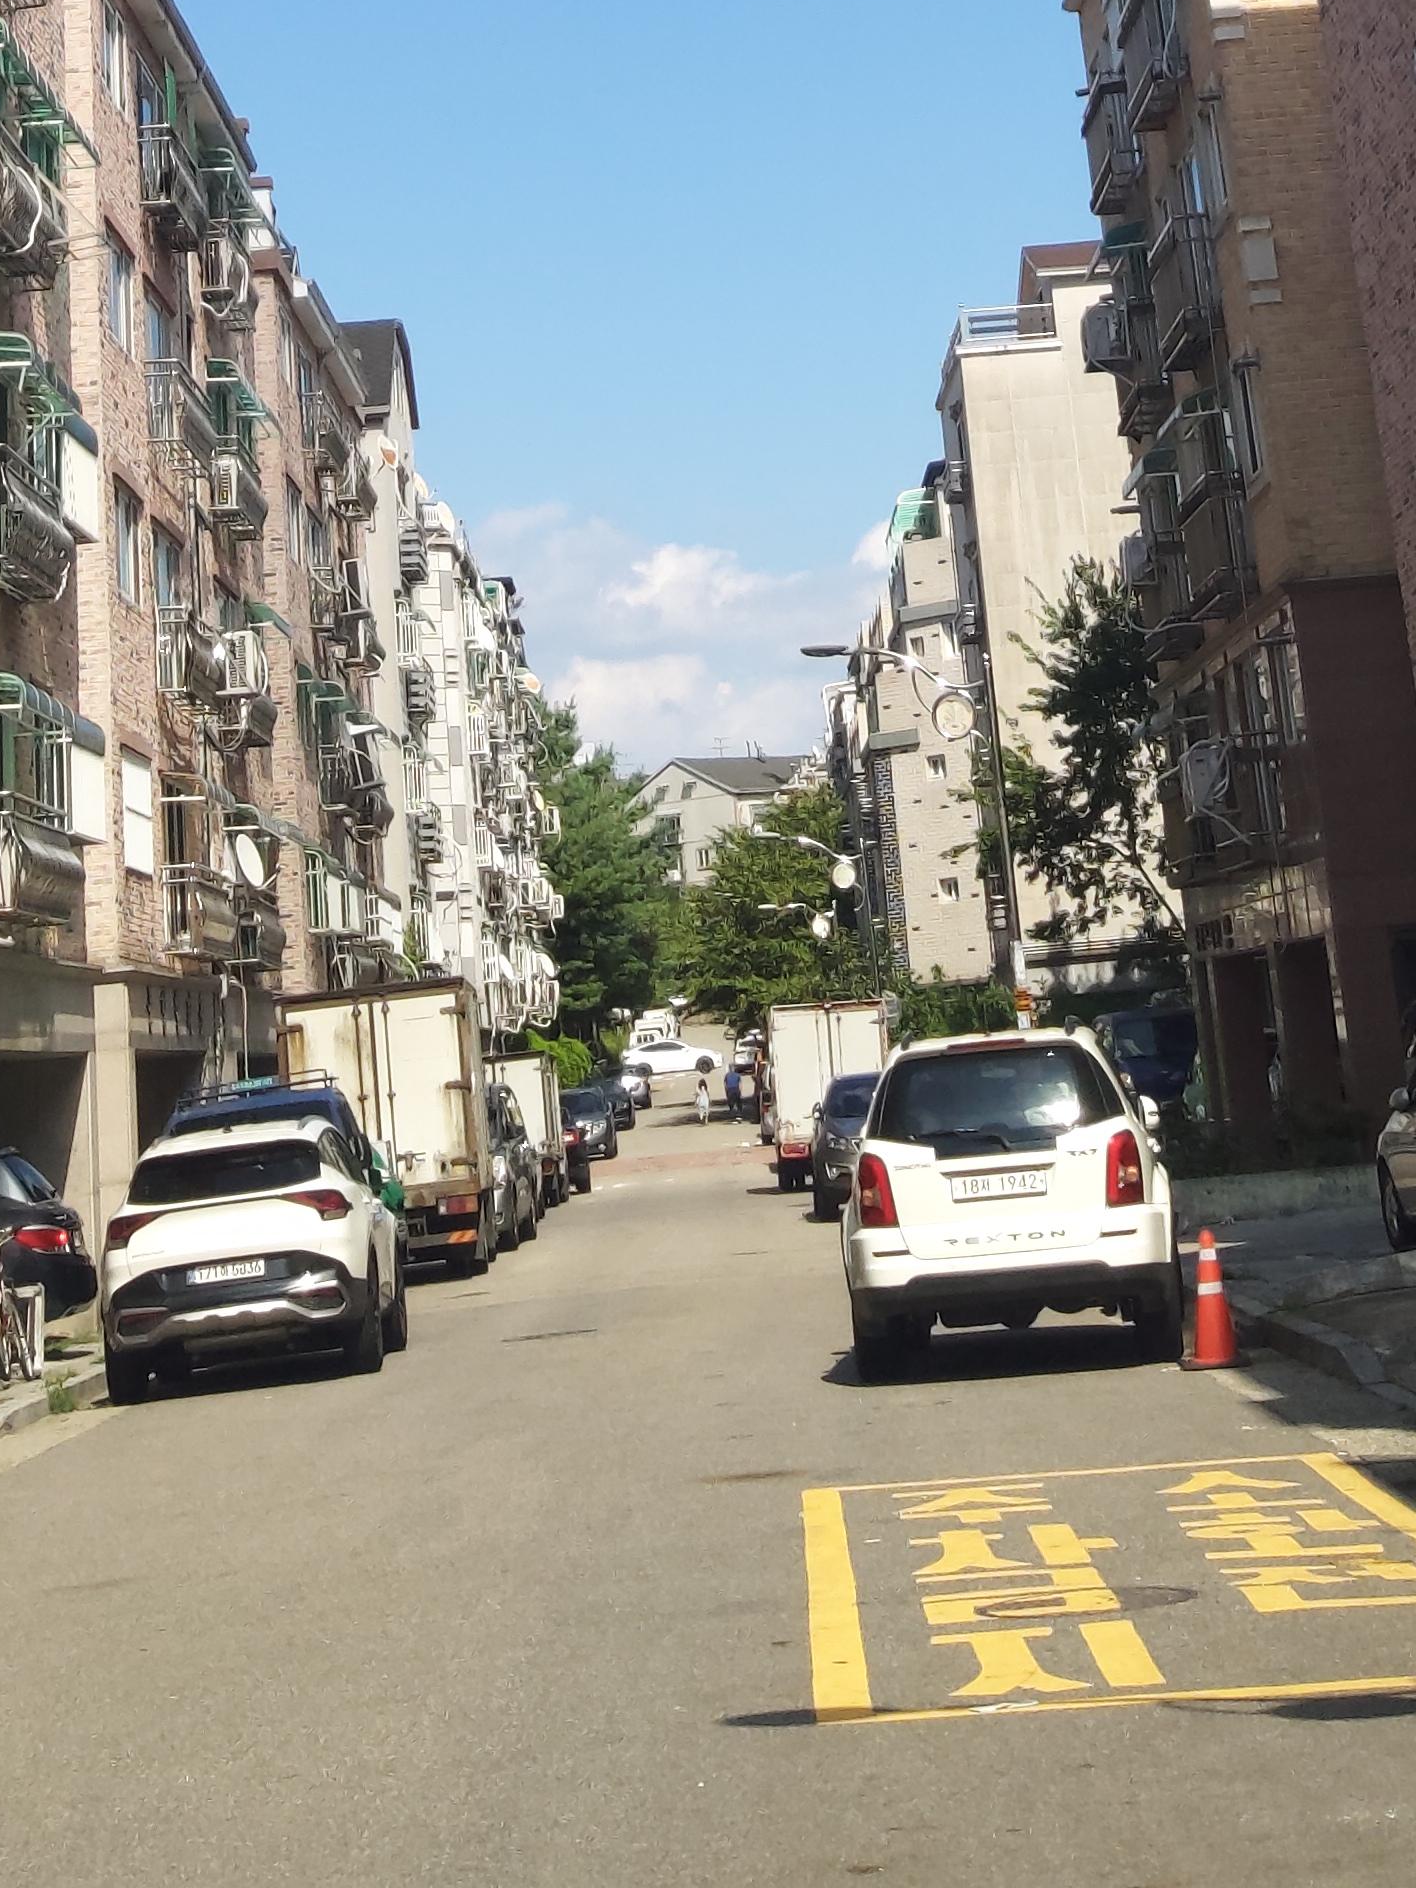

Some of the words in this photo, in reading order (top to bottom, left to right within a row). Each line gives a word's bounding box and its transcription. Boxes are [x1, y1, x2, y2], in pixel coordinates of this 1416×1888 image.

[1000, 1172, 1038, 1192] 1942
[943, 1229, 1066, 1247] REXTON
[889, 1481, 1169, 1697] 주차금지
